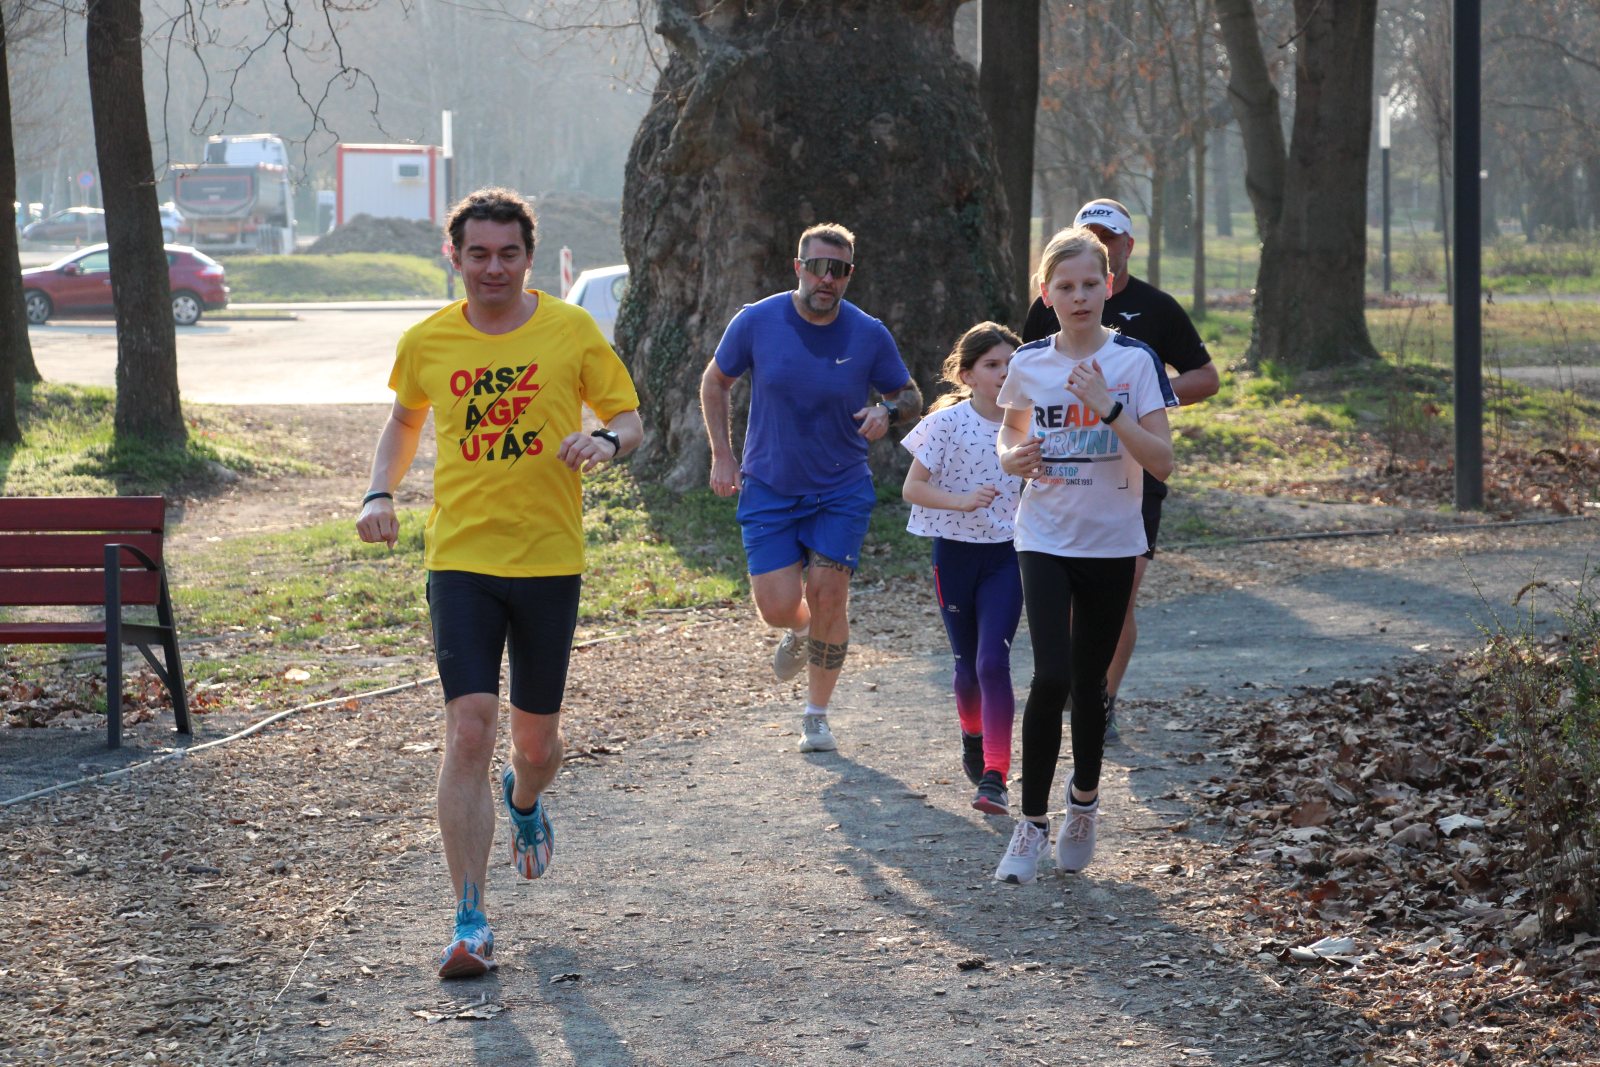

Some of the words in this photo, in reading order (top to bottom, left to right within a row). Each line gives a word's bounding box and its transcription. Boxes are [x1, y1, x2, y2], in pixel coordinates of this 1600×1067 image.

[1081, 209, 1114, 220] RUDY
[449, 363, 540, 397] ORSZ
[459, 427, 544, 462] UTÁS
